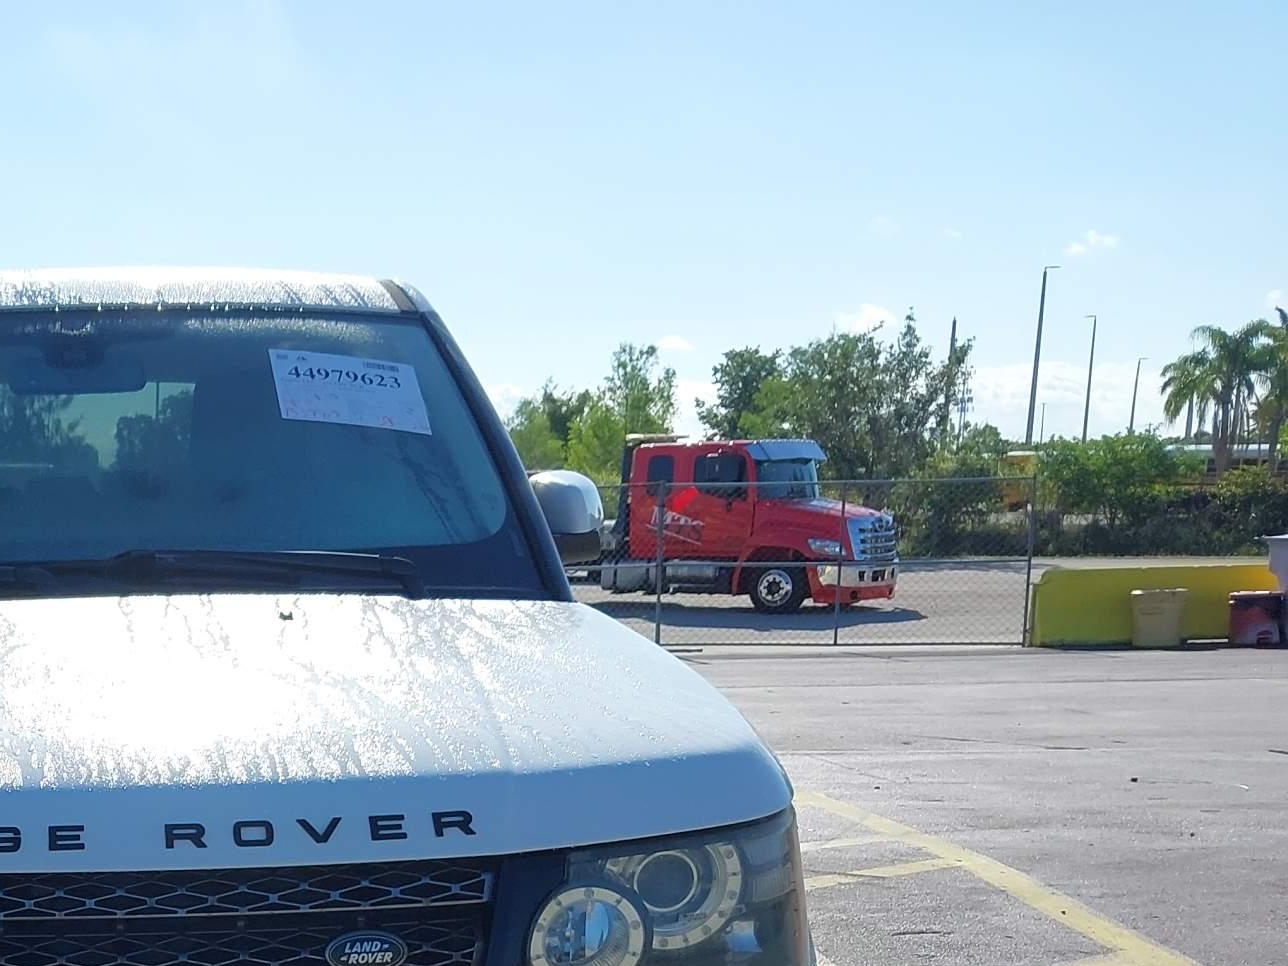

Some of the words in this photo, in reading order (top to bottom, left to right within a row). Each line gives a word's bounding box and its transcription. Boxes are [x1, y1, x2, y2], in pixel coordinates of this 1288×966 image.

[288, 365, 401, 389] 44979623
[164, 810, 477, 849] ROVER
[344, 941, 382, 954] LAND
[348, 951, 393, 965] ROVER
